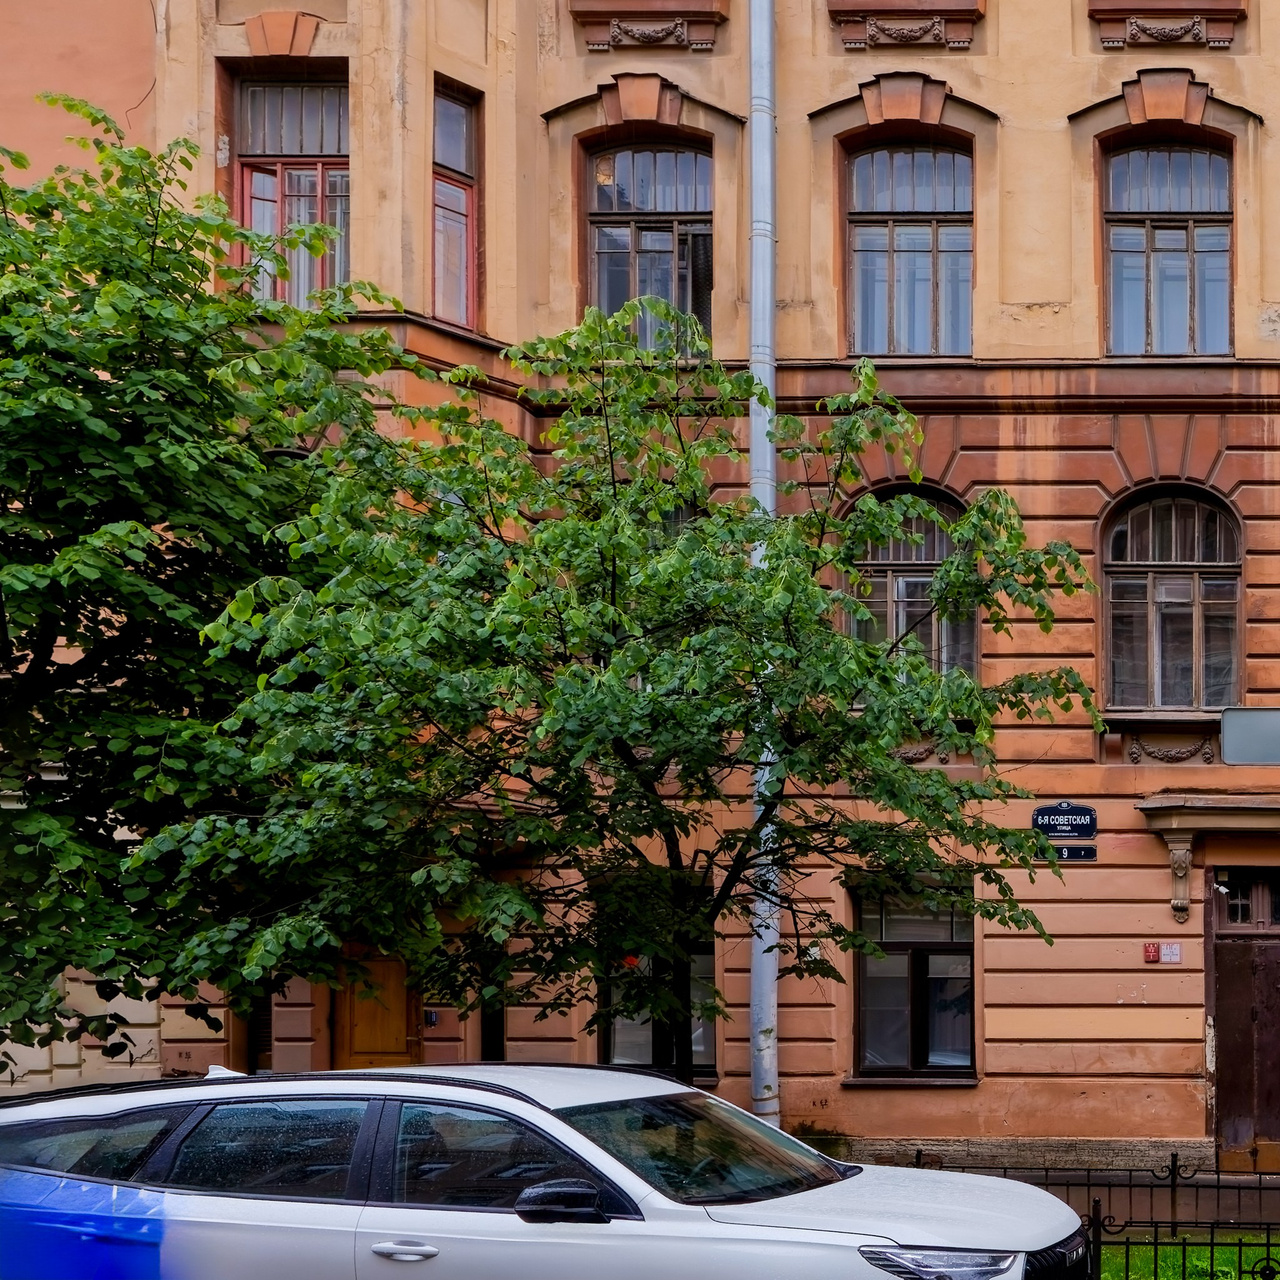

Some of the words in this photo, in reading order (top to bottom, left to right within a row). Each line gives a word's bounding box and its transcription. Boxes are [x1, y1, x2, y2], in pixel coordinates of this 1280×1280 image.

[1038, 815, 1049, 825] 6-Я
[1050, 815, 1090, 825] СОВЕТСКАЯ
[1062, 847, 1068, 859] 9
